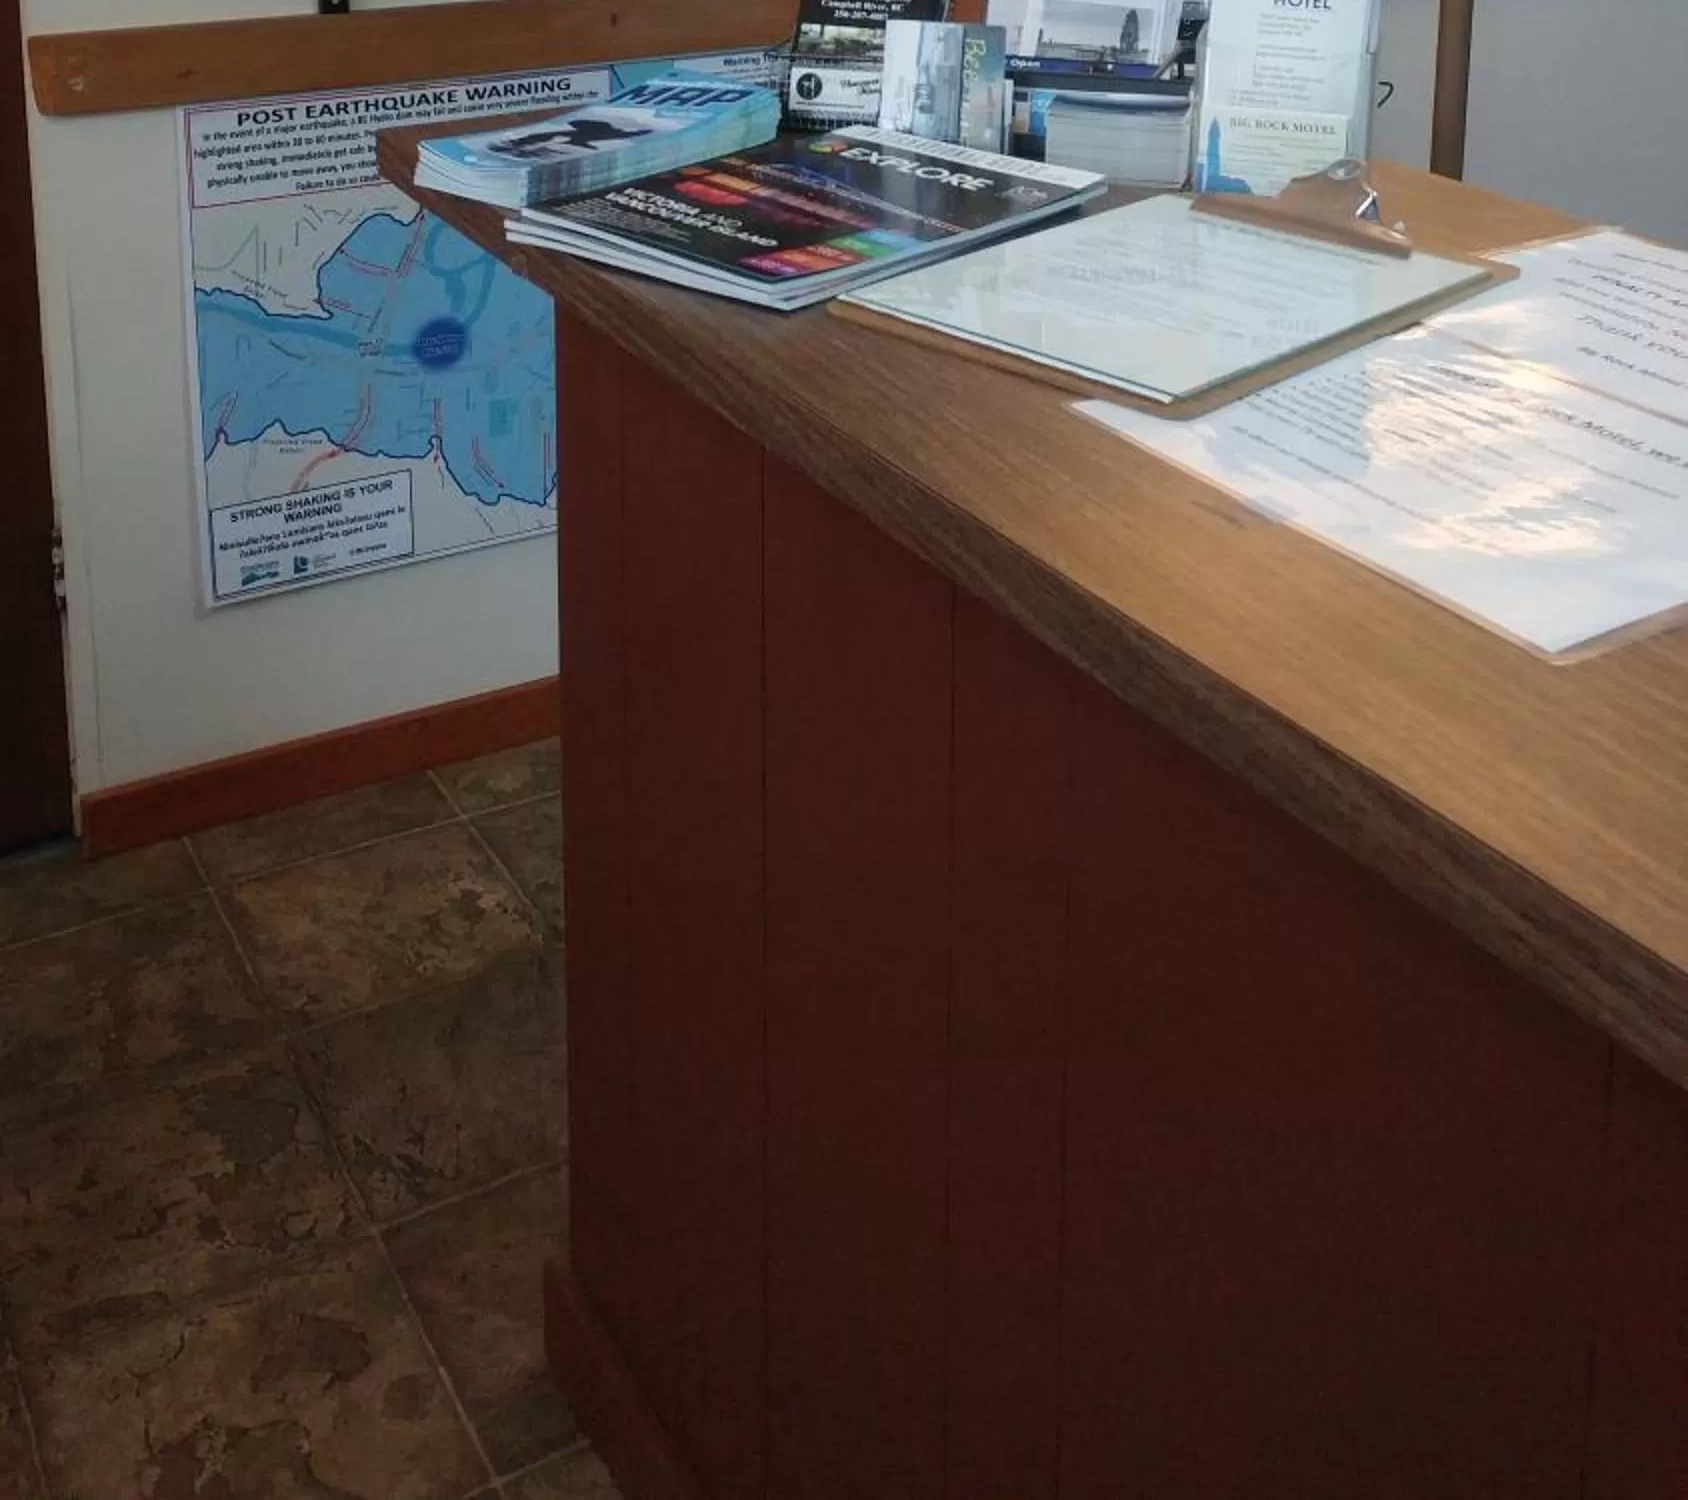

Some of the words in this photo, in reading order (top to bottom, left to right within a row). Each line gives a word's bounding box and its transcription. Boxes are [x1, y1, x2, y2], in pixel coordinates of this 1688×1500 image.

[236, 107, 298, 127] POST
[305, 90, 459, 120] EARTHQUAKE
[465, 77, 572, 101] WARNING
[840, 147, 995, 191] EXPLORE
[229, 503, 283, 523] STRONG
[285, 491, 342, 512] SHAKING
[344, 486, 356, 498] IS
[359, 479, 394, 498] YOUR
[283, 502, 343, 525] WARNING
